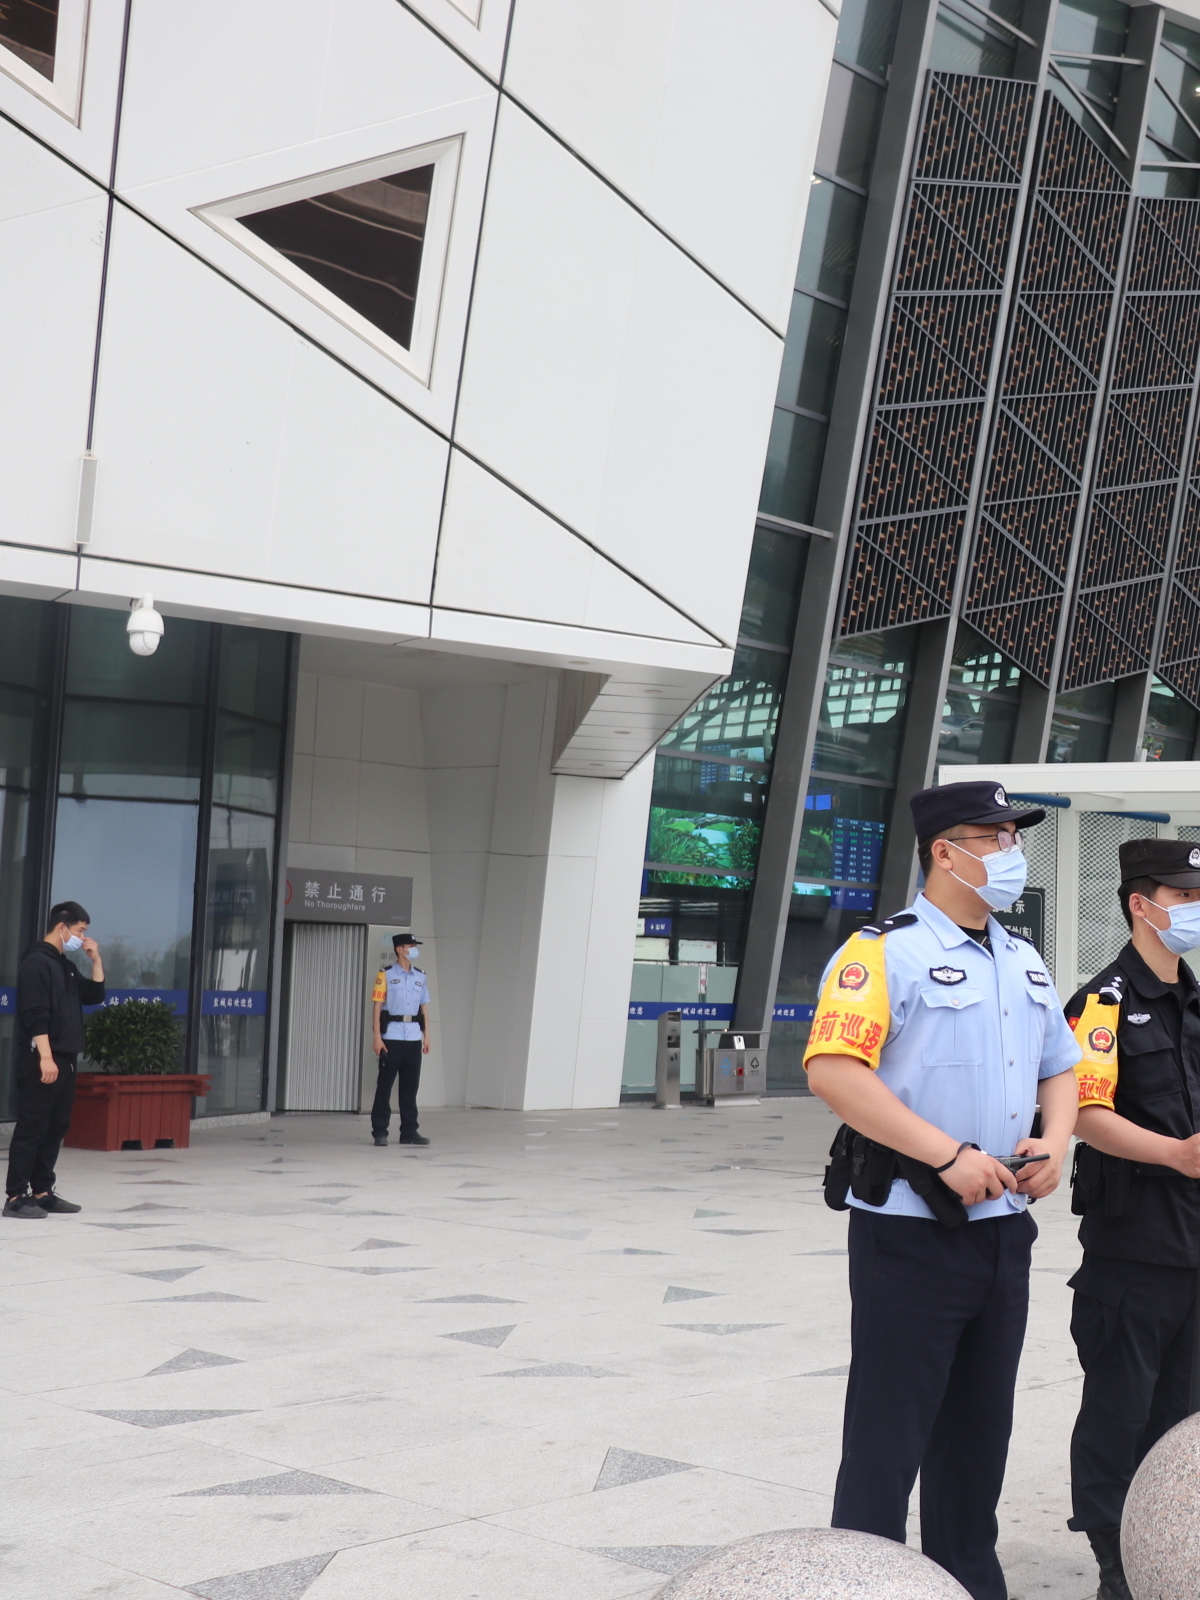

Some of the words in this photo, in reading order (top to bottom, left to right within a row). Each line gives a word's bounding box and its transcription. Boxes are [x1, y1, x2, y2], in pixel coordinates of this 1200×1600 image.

[304, 881, 386, 903] 禁止通行
[304, 900, 315, 908] No
[316, 901, 366, 911] Thoroughfare
[213, 997, 253, 1008] 盐城站欢迎您
